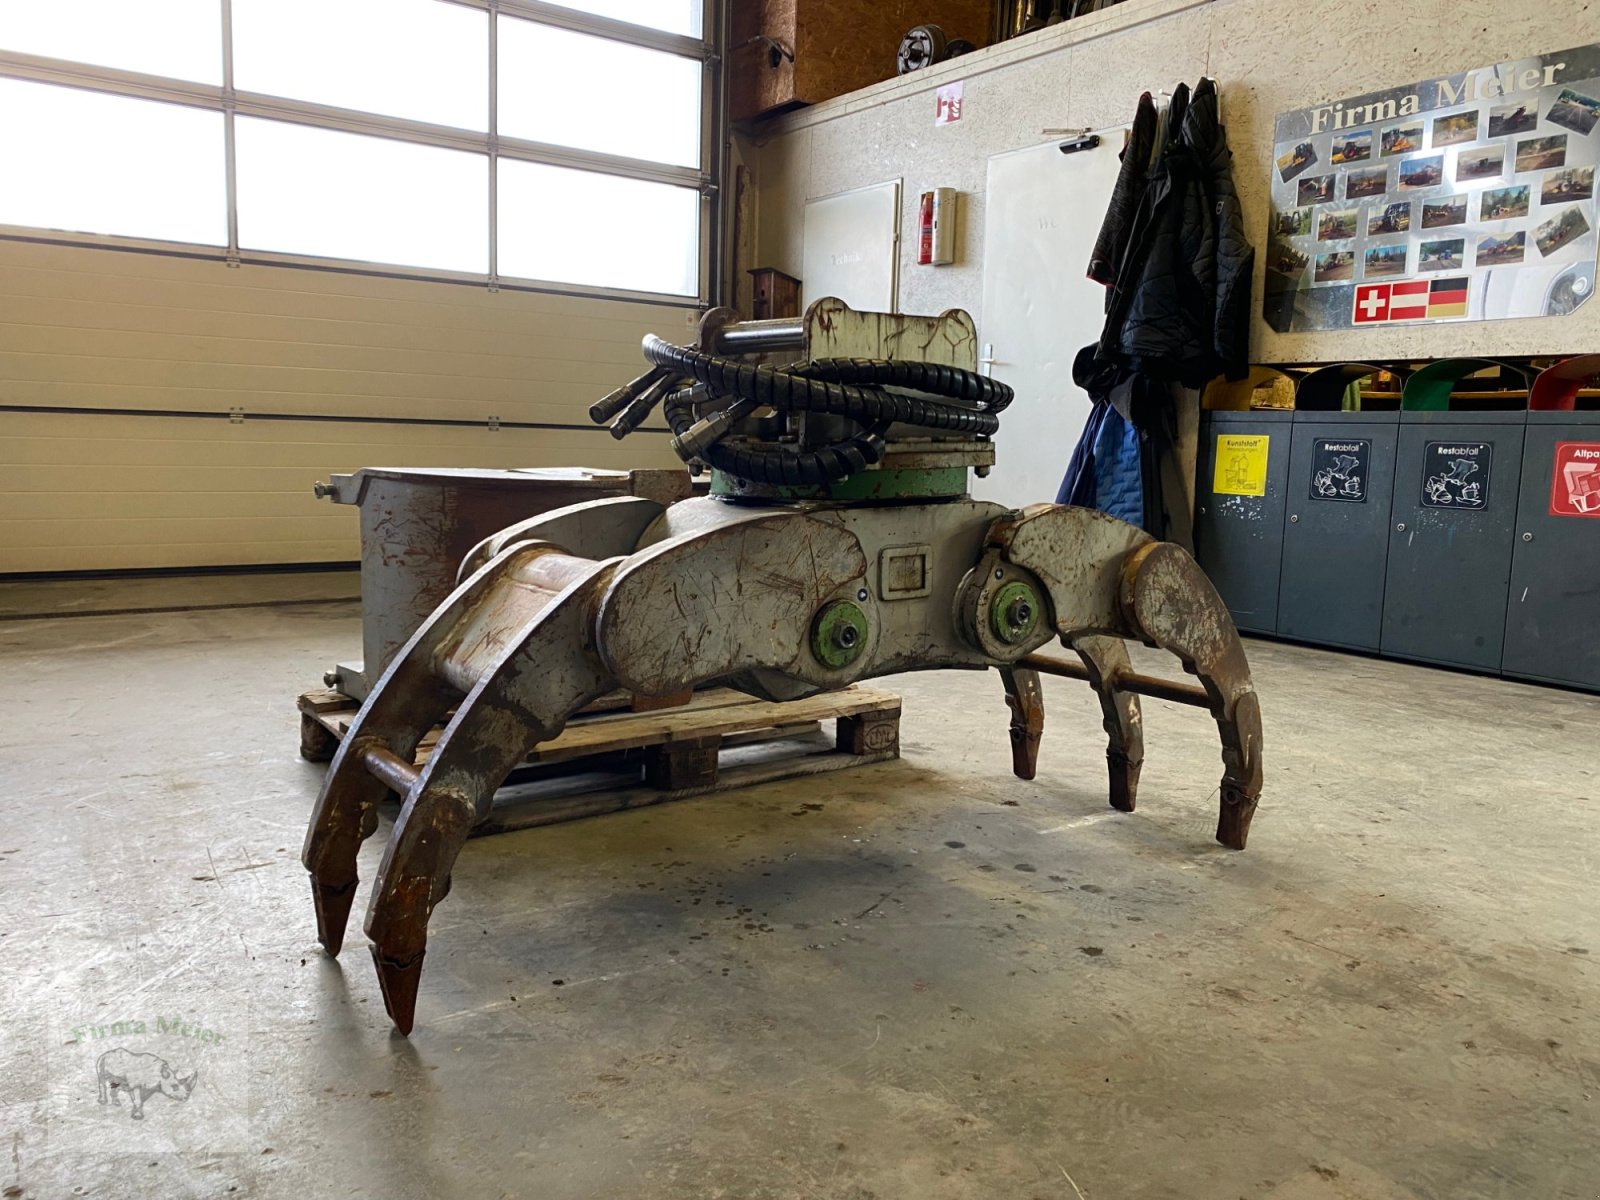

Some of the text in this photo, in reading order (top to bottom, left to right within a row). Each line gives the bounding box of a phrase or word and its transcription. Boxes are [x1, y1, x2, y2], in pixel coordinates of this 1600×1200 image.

[1308, 62, 1566, 136] Firma Meier
[1324, 443, 1360, 452] Restabfall
[1437, 446, 1479, 457] Restabfall
[1573, 449, 1600, 460] Altpa
